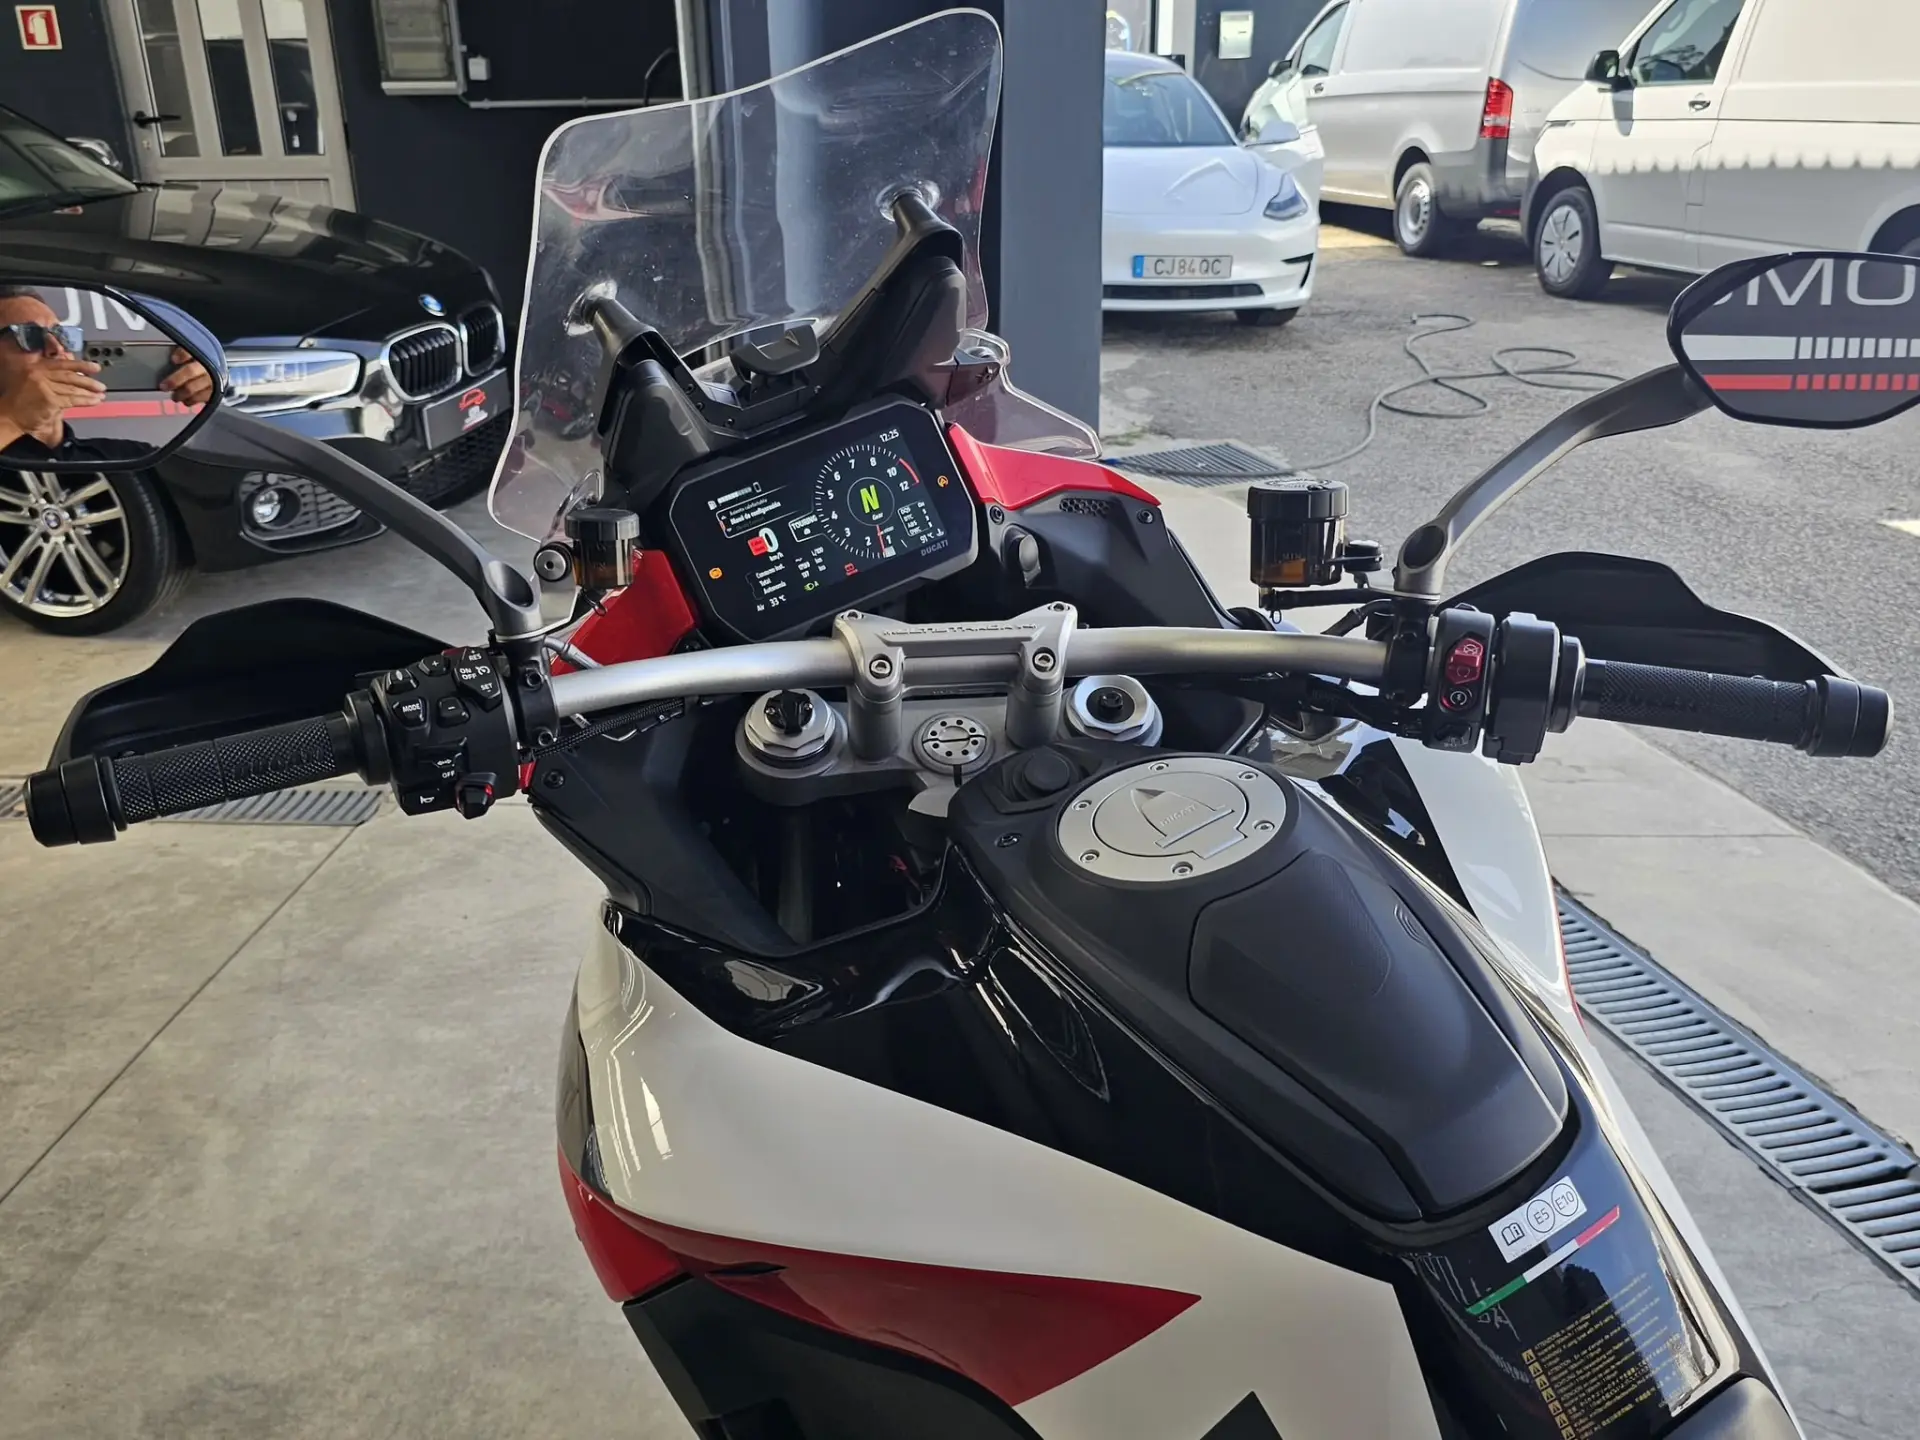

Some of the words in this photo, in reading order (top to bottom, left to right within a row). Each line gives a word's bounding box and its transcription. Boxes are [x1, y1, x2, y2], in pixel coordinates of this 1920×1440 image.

[880, 429, 899, 442] 12:25
[848, 459, 856, 469] 7
[869, 457, 877, 467] 8
[833, 471, 841, 481] 6
[887, 466, 897, 478] 10
[899, 480, 909, 491] 12
[827, 489, 834, 500] 5
[860, 485, 879, 513] N
[831, 510, 838, 520] 4
[791, 514, 818, 530] TOURING
[844, 527, 851, 538] 3
[758, 527, 779, 553] 0
[865, 536, 872, 547] 2
[887, 534, 892, 545] 1
[920, 539, 949, 557] DUCATI
[759, 577, 772, 587] Total
[769, 597, 780, 607] 33
[469, 653, 482, 661] RES
[480, 683, 493, 691] SET
[402, 703, 421, 713] MODE
[442, 770, 455, 778] OFF
[1555, 1192, 1575, 1210] E10
[1533, 1210, 1550, 1226] E5
